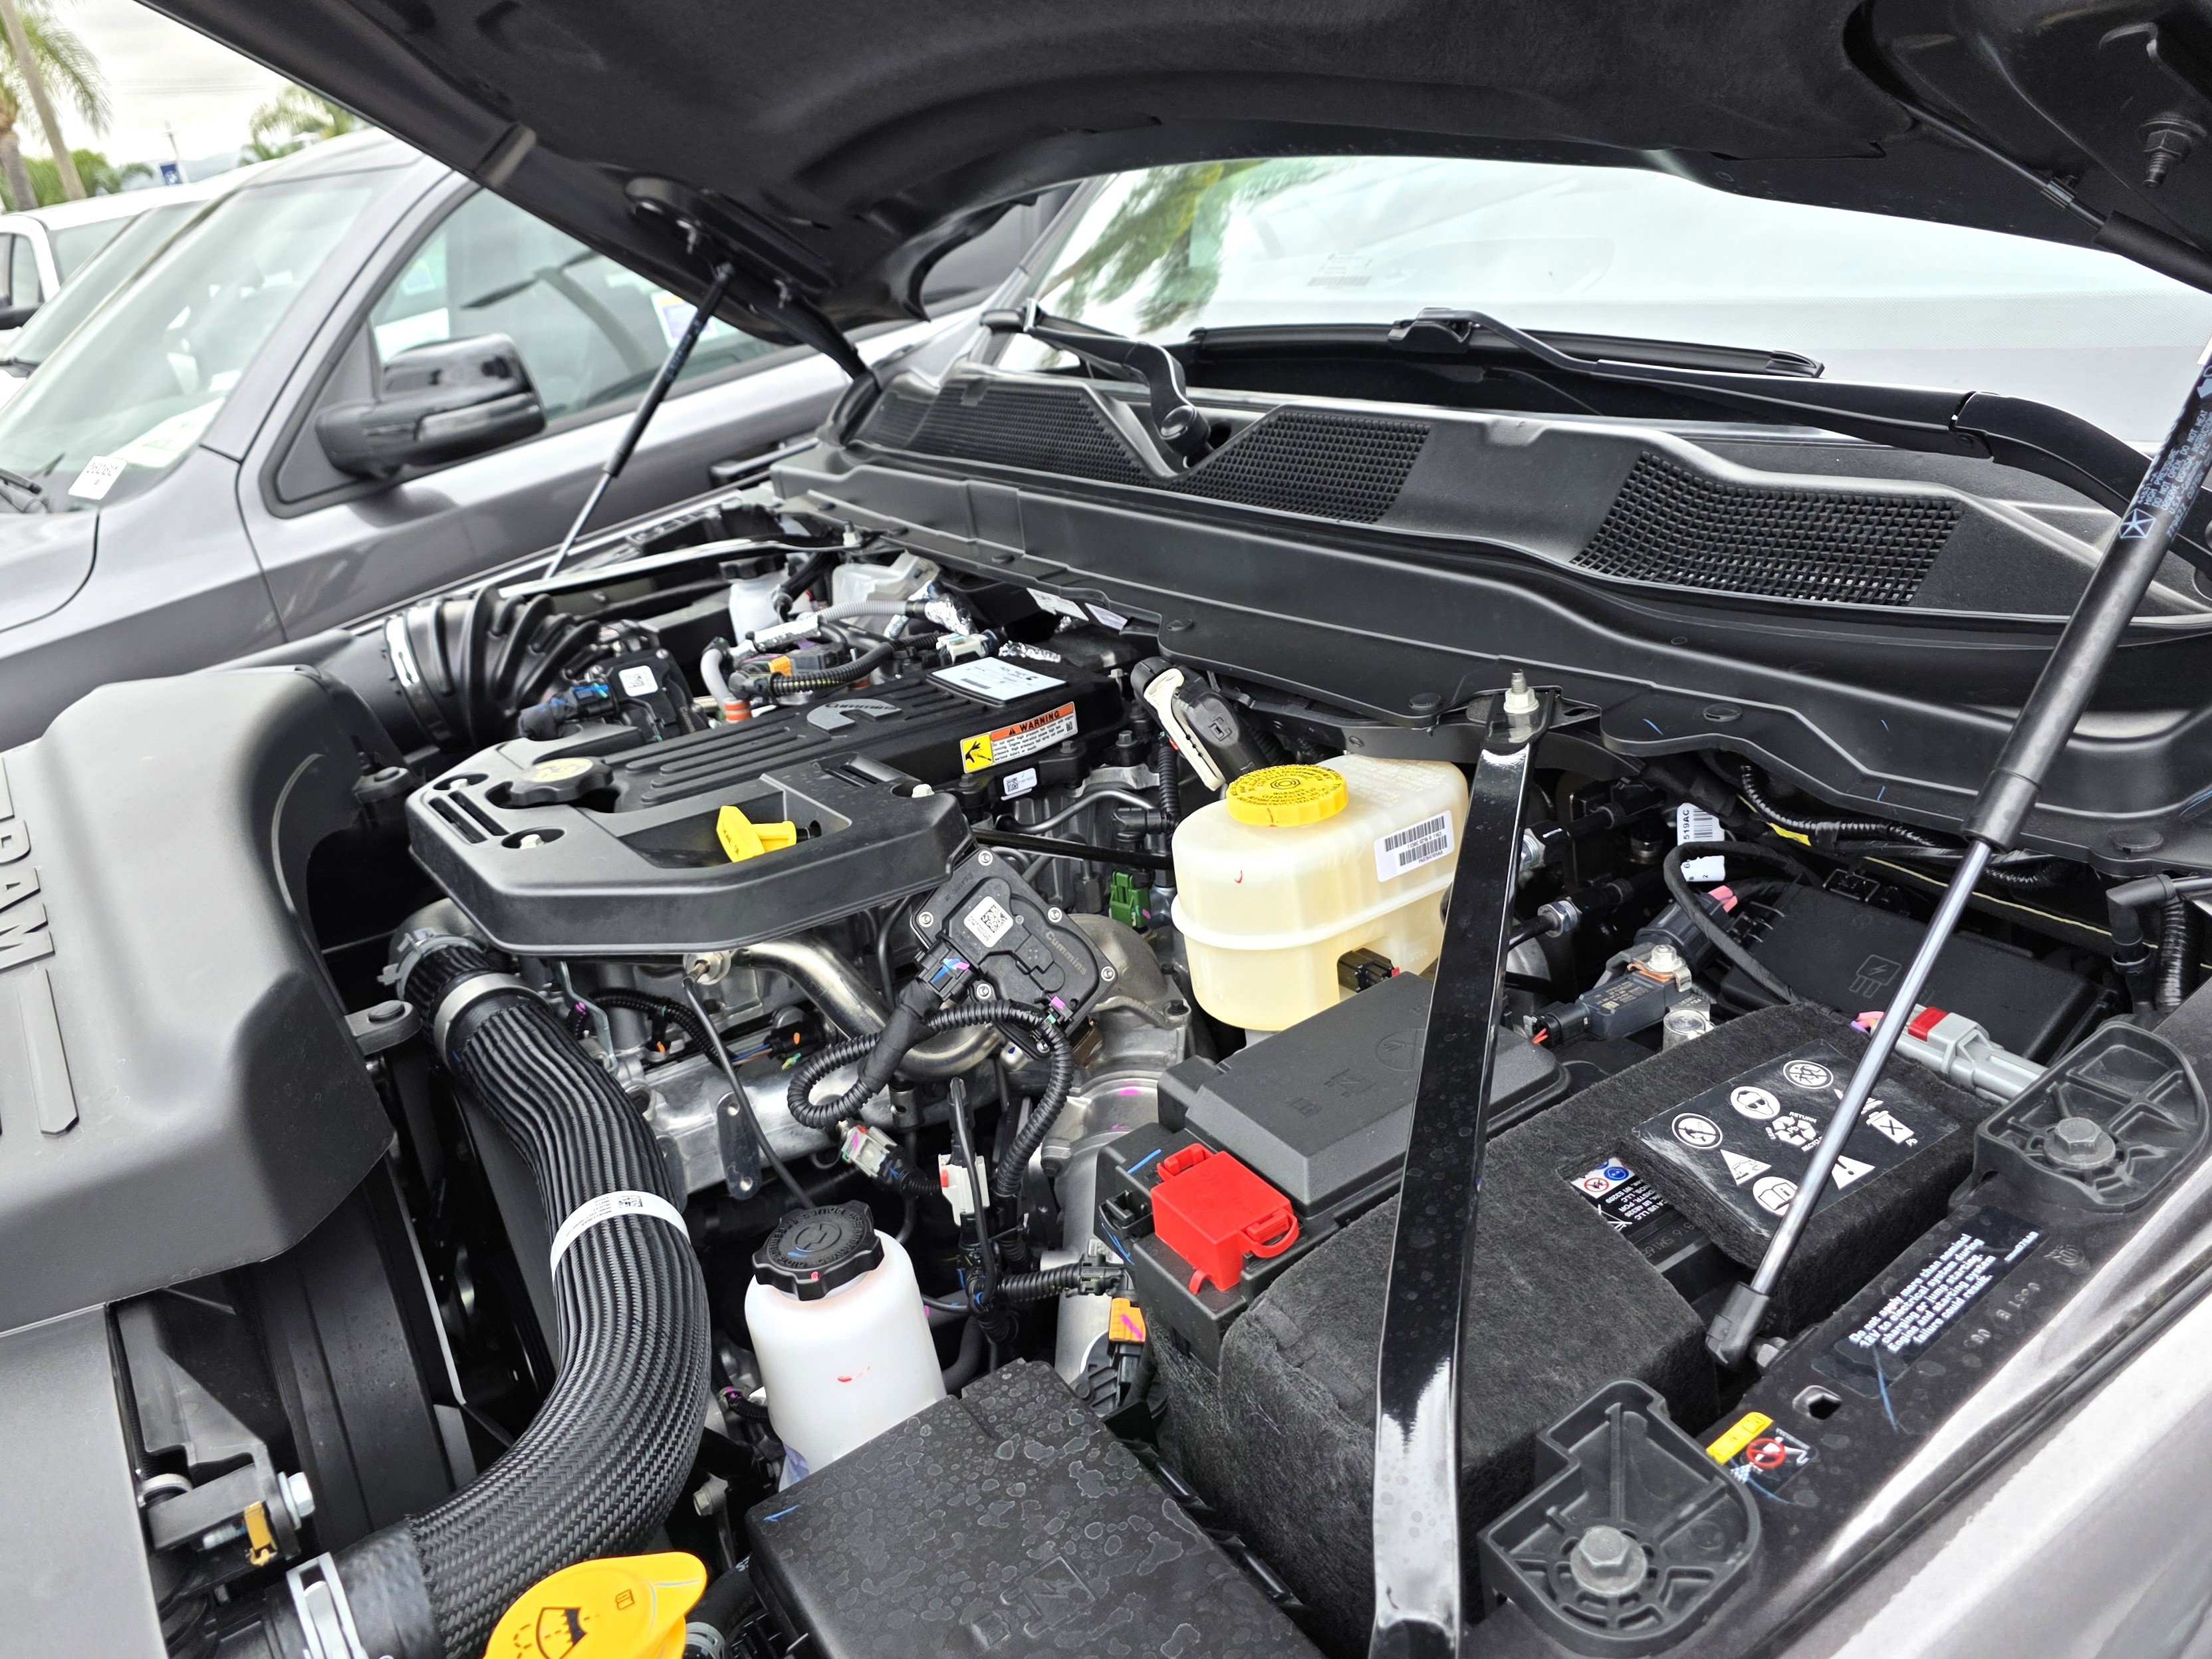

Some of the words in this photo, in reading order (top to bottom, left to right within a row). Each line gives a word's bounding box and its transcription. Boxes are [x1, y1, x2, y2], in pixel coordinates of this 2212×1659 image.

[2151, 498, 2162, 507] DO
[2158, 481, 2171, 493] NOT
[2179, 446, 2191, 454] DO
[2186, 430, 2198, 441] NOT
[2193, 410, 2209, 425] HEAT
[2153, 448, 2179, 484] PRESSURE
[2159, 485, 2179, 509] OBSERVE
[2175, 455, 2195, 481] DISPOSAL
[1019, 710, 1061, 731] WARNING
[1045, 930, 1088, 975] Cummins
[1789, 1111, 1817, 1123] RETURN
[1905, 1138, 1918, 1148] Pb
[1618, 1202, 1634, 1212] POR
[1620, 1192, 1634, 1202] LLC
[1632, 1189, 1655, 1204] DISTR.
[1633, 1210, 1650, 1220] LLC
[1848, 1329, 1867, 1342] Do
[1863, 1316, 1882, 1330] not
[1877, 1295, 1905, 1317] apply
[1900, 1278, 1923, 1296] more
[1919, 1259, 1943, 1277] than
[1939, 1233, 1972, 1260] nominal
[1858, 1330, 1882, 1348] 12V
[1877, 1319, 1894, 1331] to
[1888, 1285, 1931, 1319] electrical
[1927, 1261, 1959, 1287] system
[1953, 1237, 1985, 1262] during
[1880, 1311, 1919, 1344] charging
[1915, 1301, 1929, 1311] or
[1924, 1283, 1949, 1302] jump
[1945, 1252, 1985, 1285] starting.
[1886, 1325, 1921, 1352] Engine
[1915, 1311, 1935, 1325] and
[1930, 1279, 1970, 1311] starting
[1964, 1254, 1998, 1281] system
[1911, 1317, 1945, 1343] failure
[1939, 1297, 1965, 1317] could
[1961, 1271, 1993, 1297] result.
